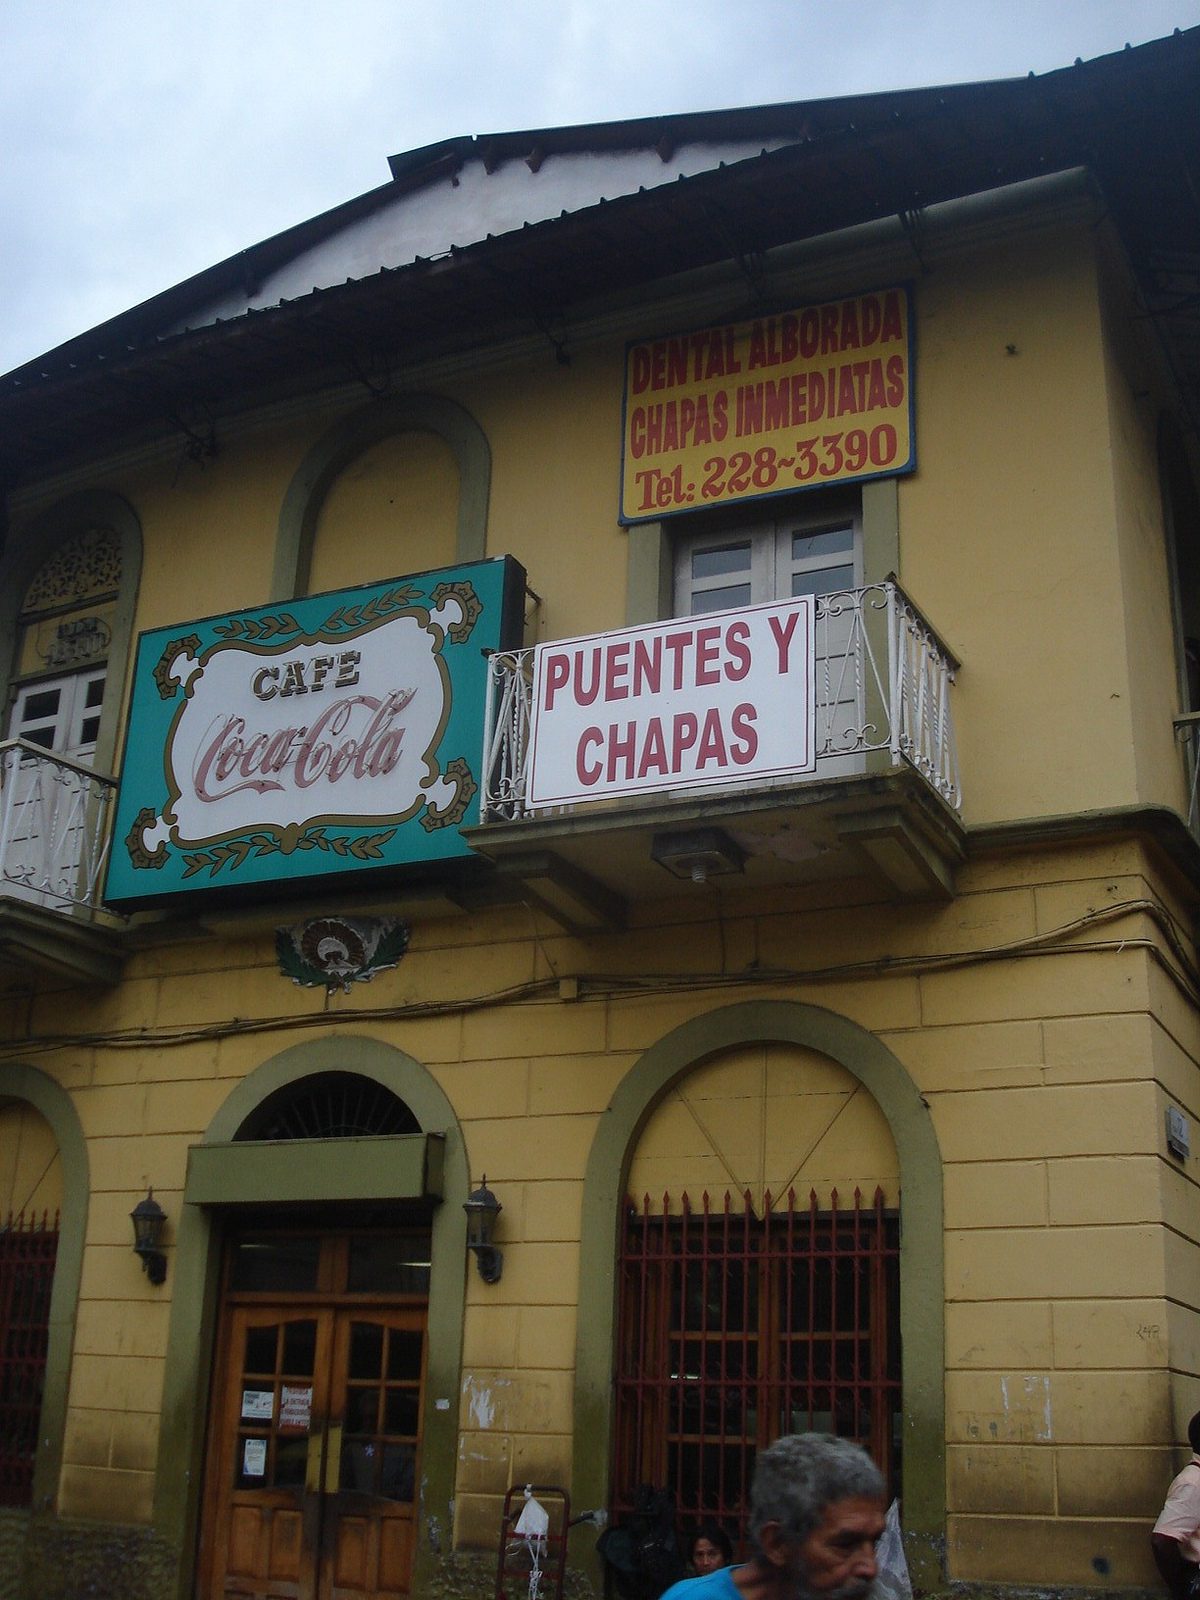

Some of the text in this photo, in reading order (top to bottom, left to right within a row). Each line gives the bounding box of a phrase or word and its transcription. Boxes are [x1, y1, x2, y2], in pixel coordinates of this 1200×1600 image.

[632, 292, 903, 394] DENTAL ALBORADA
[630, 355, 904, 459] CHAPAS INMEDIATAS
[635, 464, 695, 511] Tel:
[544, 612, 800, 711] PUENTES Y
[192, 687, 418, 803] Coca-Cola
[576, 702, 759, 786] CHAPAS
